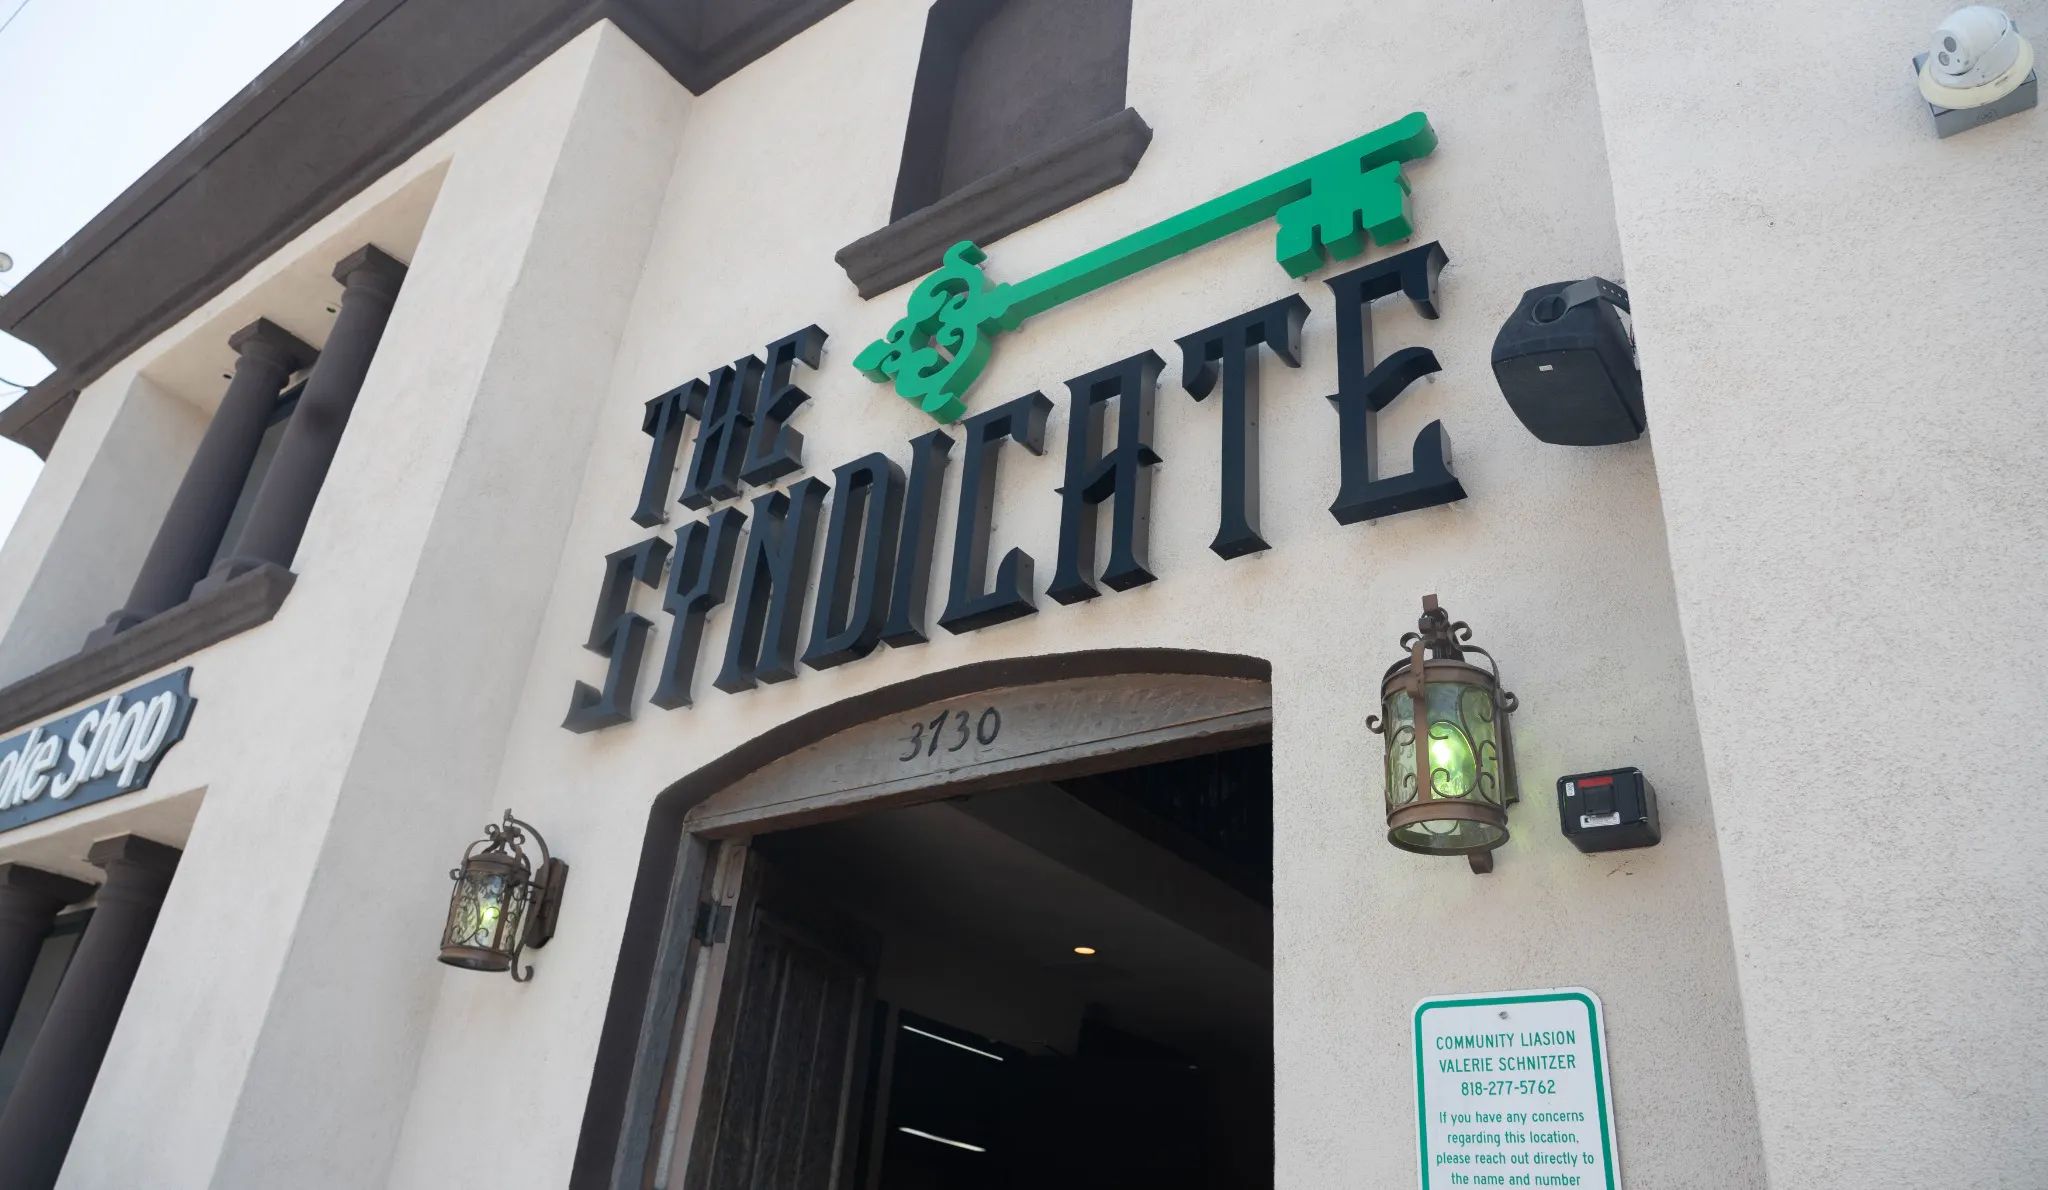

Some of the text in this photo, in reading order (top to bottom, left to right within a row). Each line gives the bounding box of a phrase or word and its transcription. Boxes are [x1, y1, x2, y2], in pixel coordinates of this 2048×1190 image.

[630, 323, 829, 529] THE
[562, 240, 1469, 734] SYNDICATE
[51, 690, 177, 799] Shop
[1436, 1030, 1576, 1050] COMMUNITY LIASION
[1439, 1054, 1576, 1073] VALERIE SCHNITZER
[1461, 1079, 1556, 1096] 818-277-5762
[1439, 1111, 1585, 1126] If you have any concerns
[1447, 1131, 1500, 1147] regarding
[1504, 1131, 1526, 1144] this
[1436, 1152, 1595, 1167] please reach out directly to
[1451, 1172, 1581, 1186] the name and number
